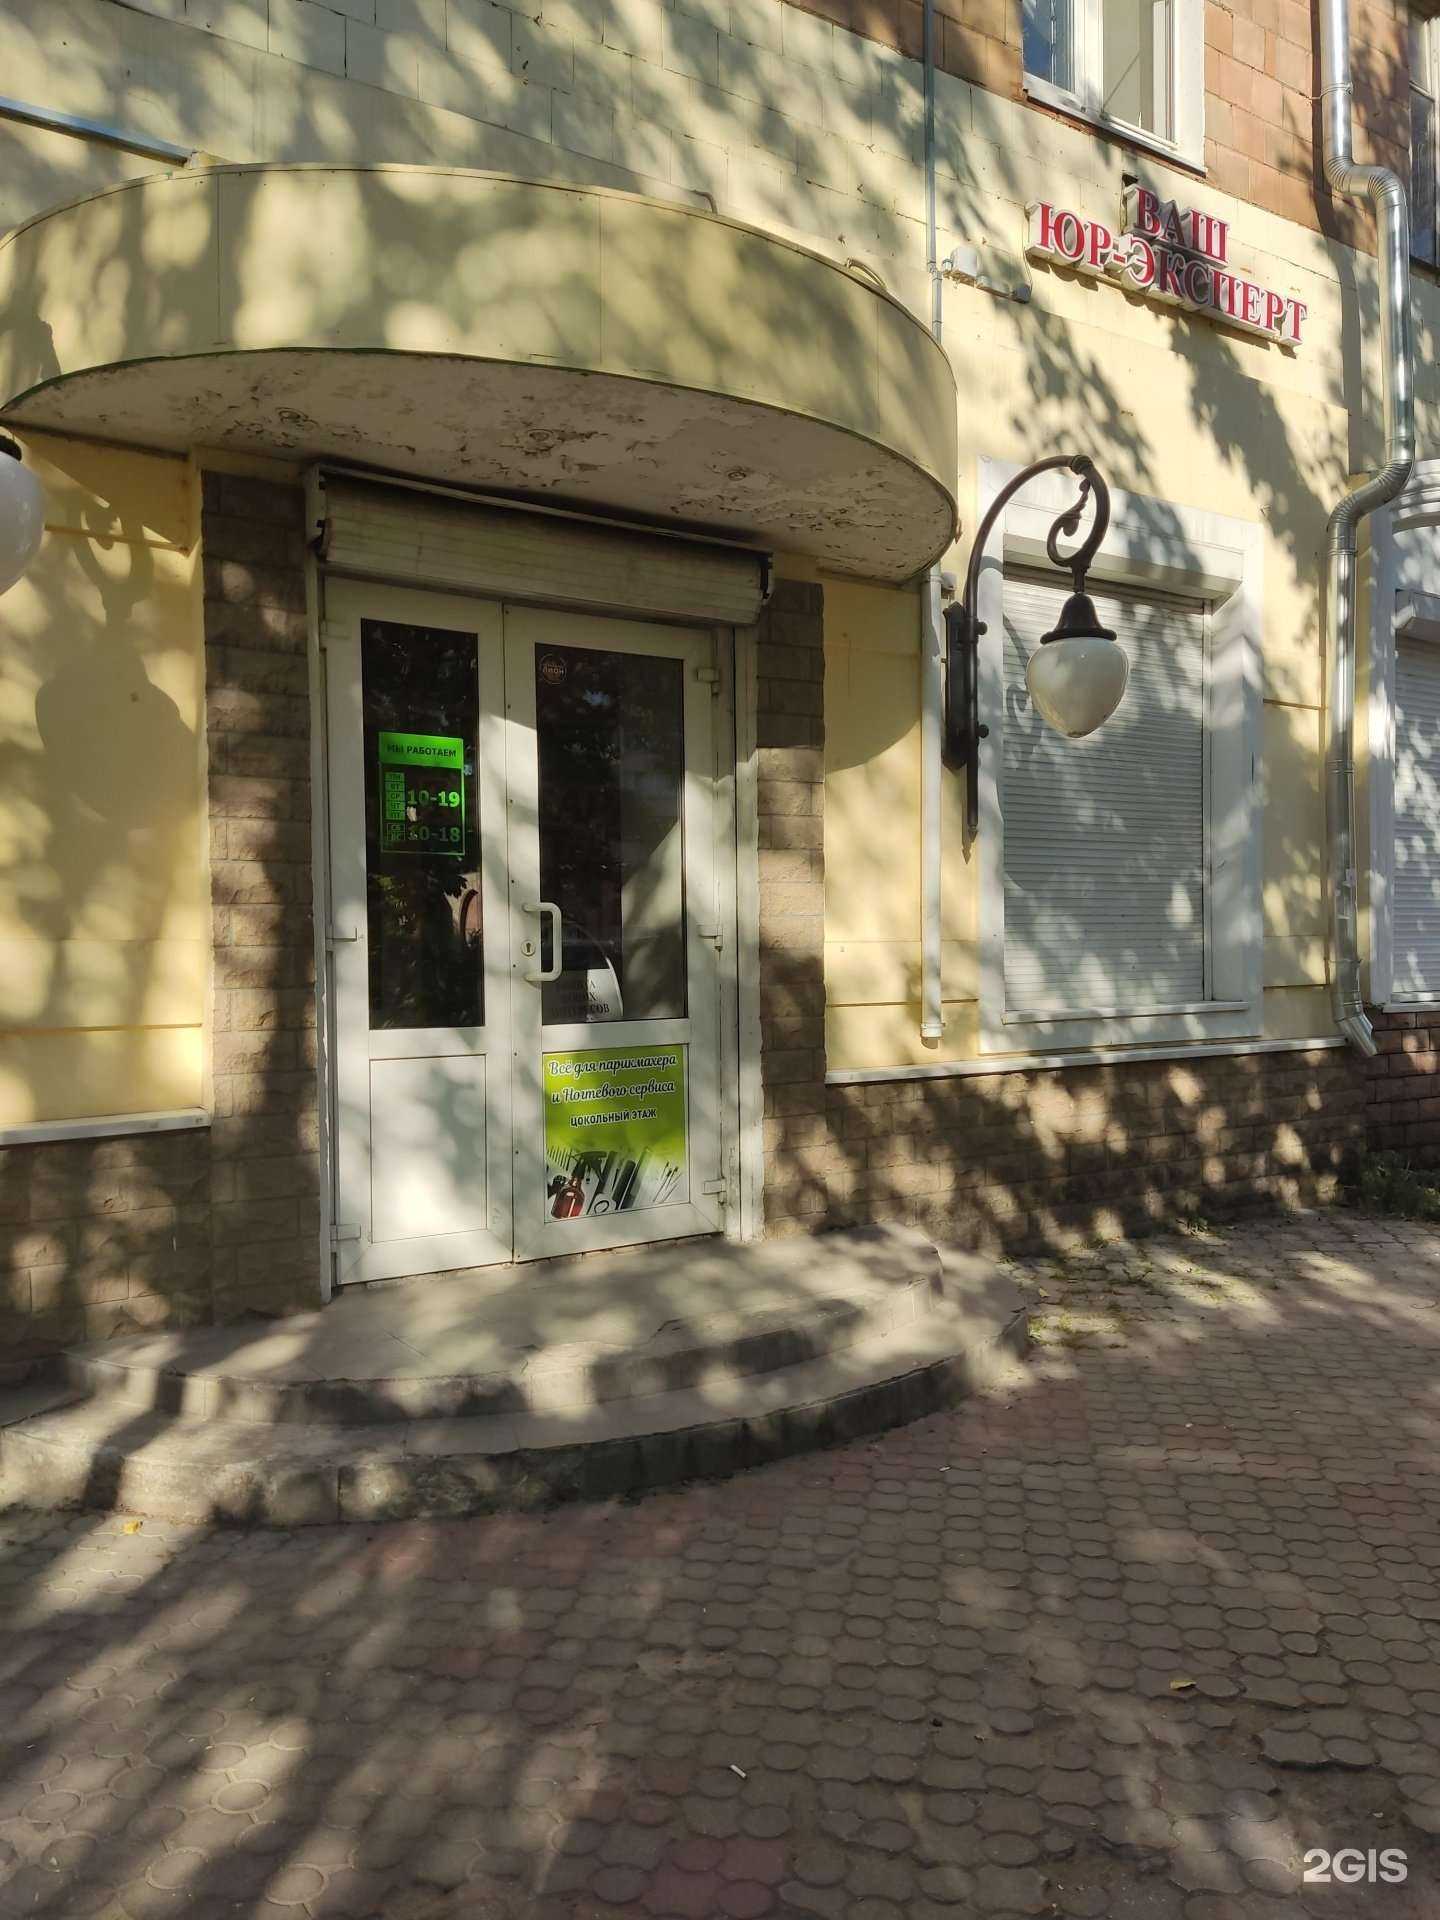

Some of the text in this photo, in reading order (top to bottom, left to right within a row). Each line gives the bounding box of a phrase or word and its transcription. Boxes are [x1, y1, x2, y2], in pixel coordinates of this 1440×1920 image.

[1133, 186, 1230, 265] ВАШ
[1035, 200, 1308, 342] ЮР-ЭКСПЕРТ
[386, 743, 457, 757] МЫ РАБОТАЕМ
[407, 789, 460, 808] 10-19
[574, 1062, 597, 1078] для
[598, 1055, 676, 1076] парикмахера
[551, 1079, 675, 1103] и Ногтевого сервиса
[570, 1108, 657, 1127] ЦОКОЛЬНЫЙ ЭТАЖ
